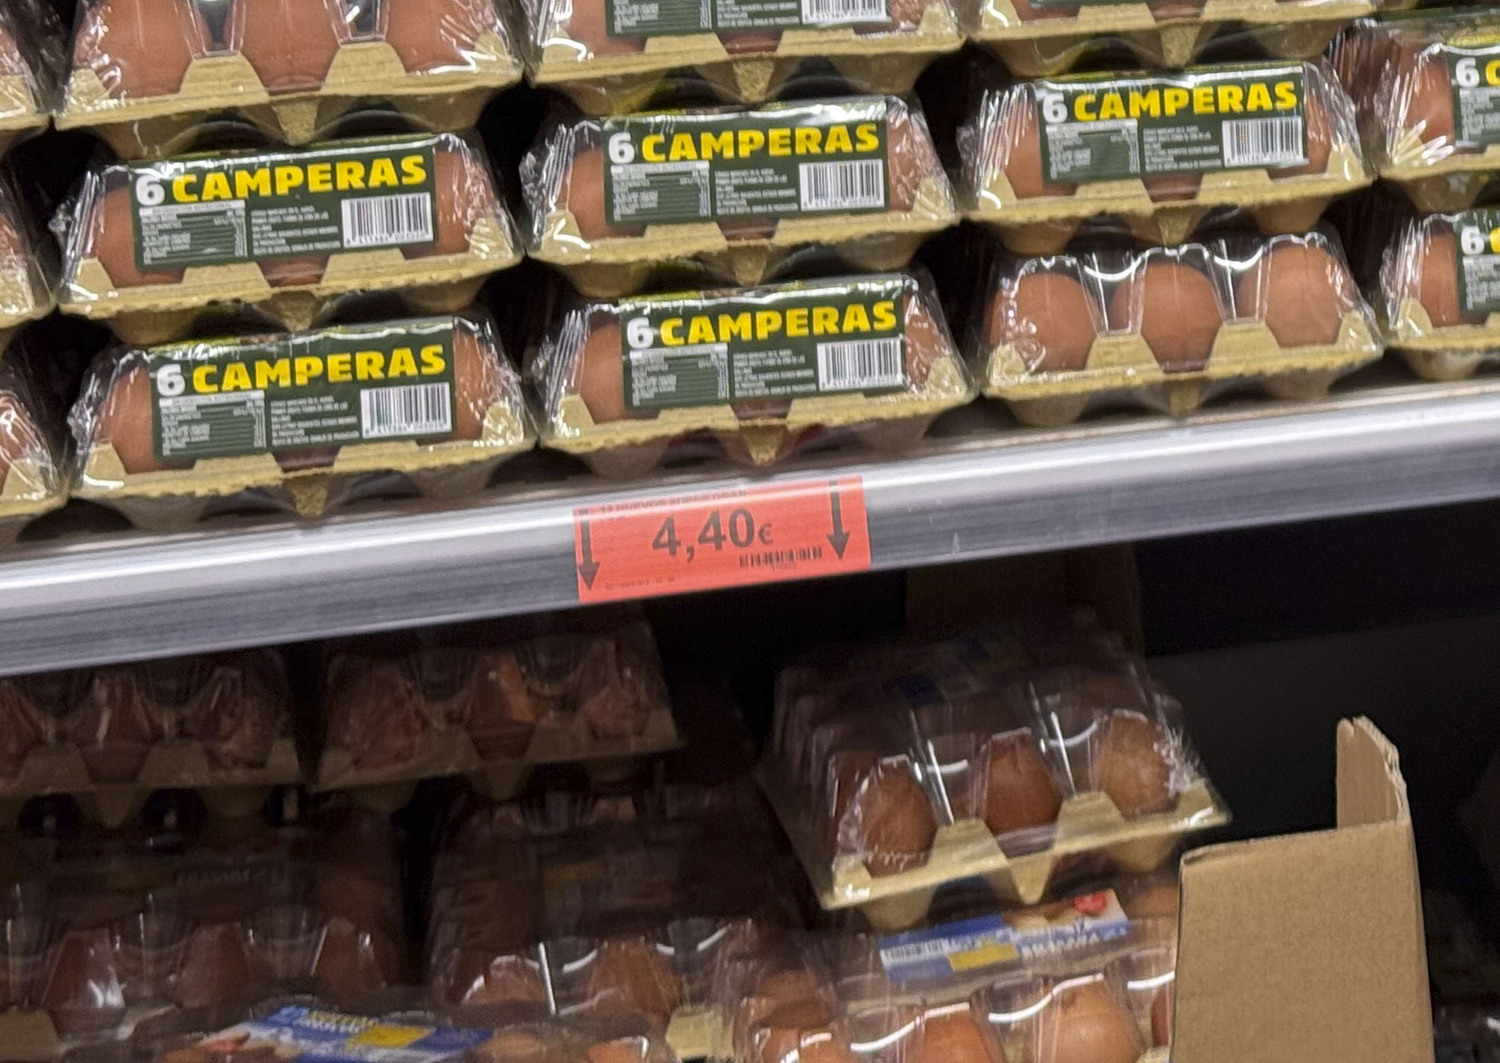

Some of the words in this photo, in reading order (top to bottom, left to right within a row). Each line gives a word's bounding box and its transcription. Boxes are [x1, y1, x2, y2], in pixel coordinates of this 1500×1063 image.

[1455, 57, 1480, 88] 6
[1042, 93, 1068, 124] 6
[1074, 81, 1298, 122] CAMPERAS
[608, 132, 635, 164] 6
[641, 123, 880, 163] CAMPERAS
[135, 175, 165, 206] 6
[172, 153, 427, 204] CAMPERAS
[1460, 226, 1486, 255] 6
[627, 317, 653, 349] 6
[660, 300, 898, 347] CAMPERAS
[156, 363, 186, 397] 6
[192, 344, 447, 394] CAMPERAS
[652, 508, 774, 563] 4,40€
